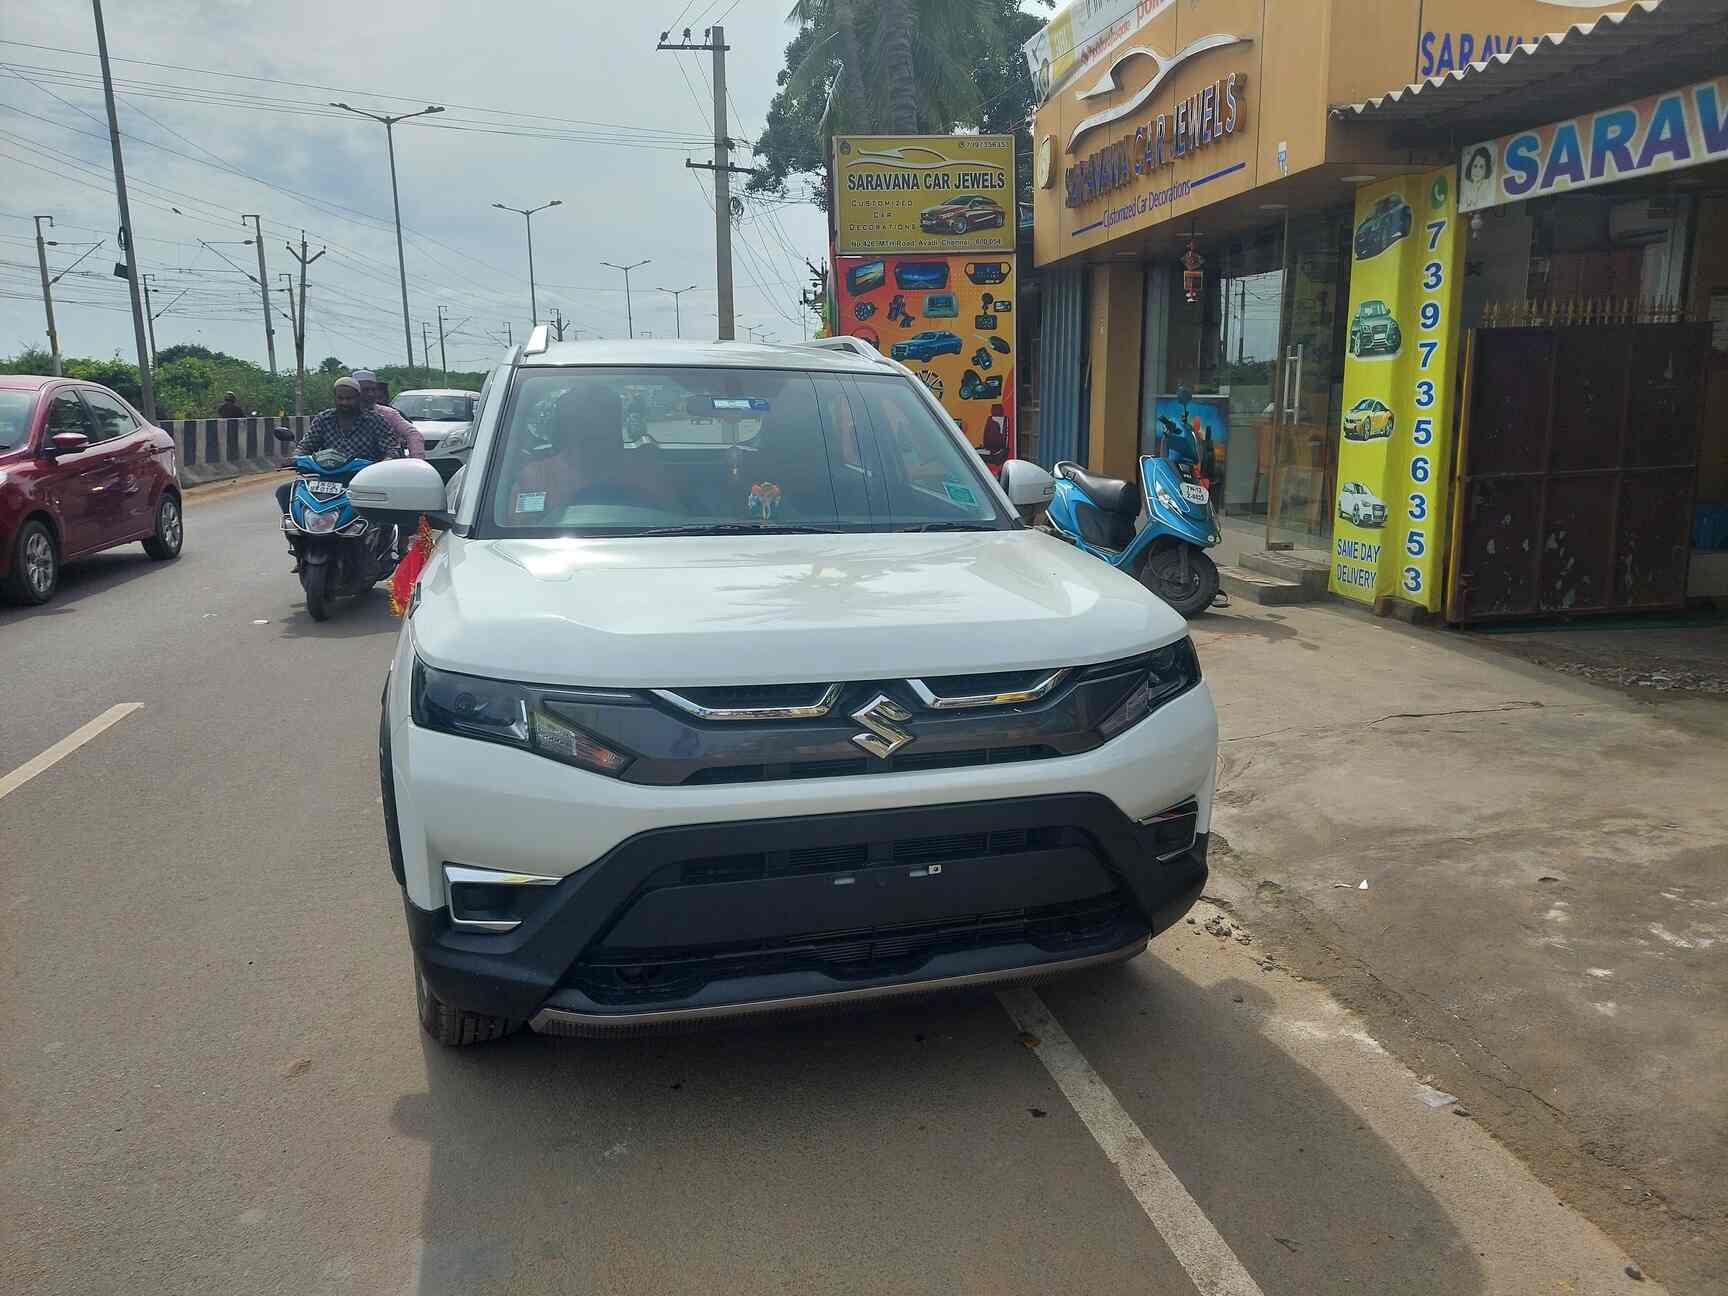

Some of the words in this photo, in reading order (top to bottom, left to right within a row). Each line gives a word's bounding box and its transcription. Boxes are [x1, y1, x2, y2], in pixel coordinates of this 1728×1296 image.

[848, 174, 920, 191] SARAVANA
[924, 173, 951, 190] CAR
[954, 172, 1005, 190] JEWELS
[1103, 200, 1136, 229] Customized
[1136, 194, 1149, 216] Car
[1149, 179, 1191, 211] Decorations
[1337, 538, 1358, 560] SAME
[1360, 542, 1381, 563] DAY
[1336, 563, 1376, 589] DELIVERY
